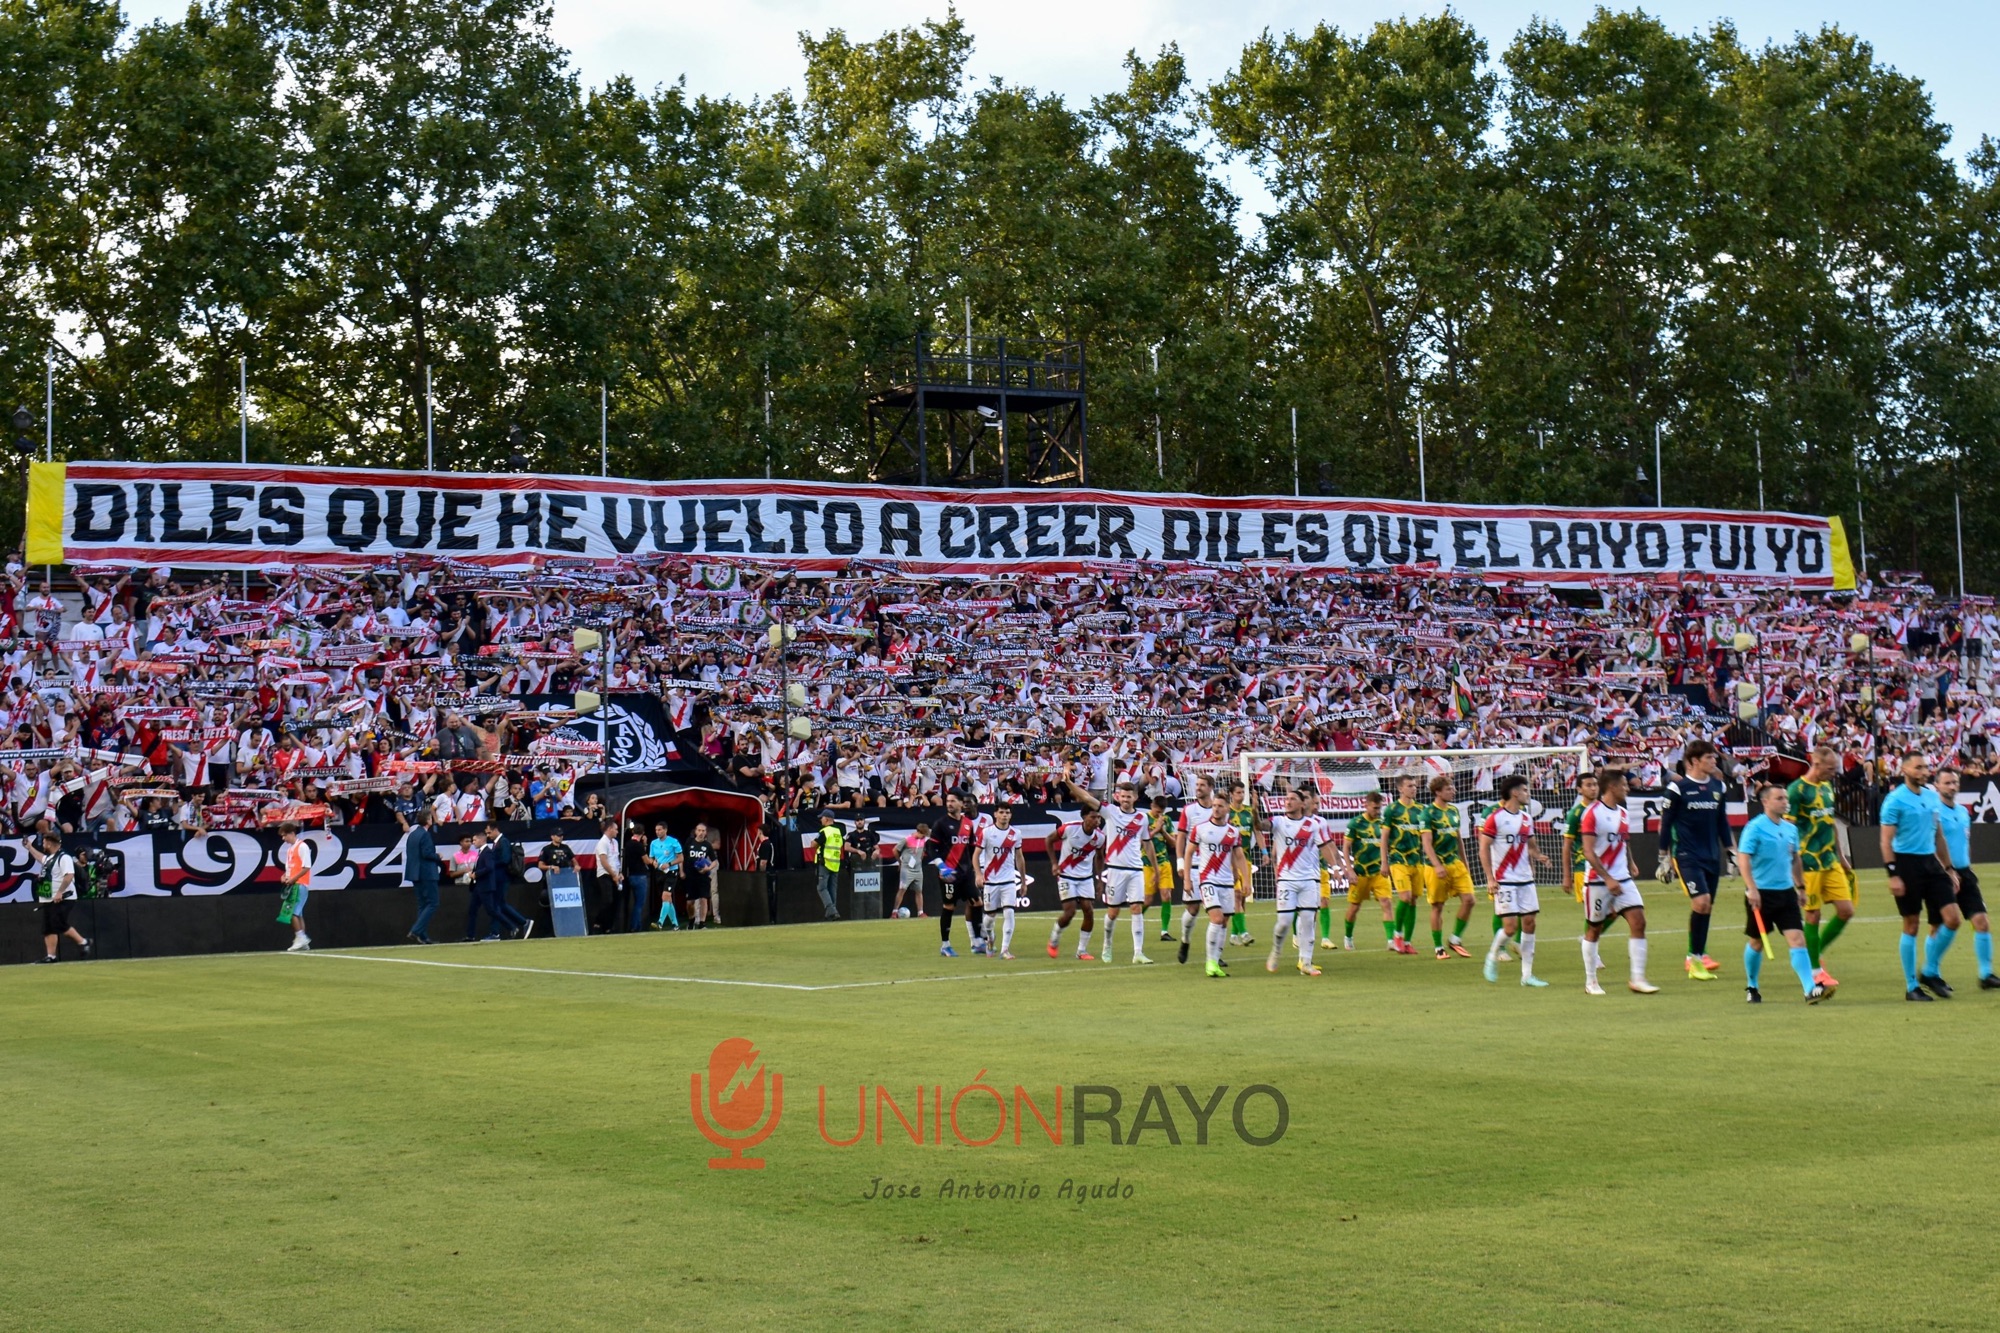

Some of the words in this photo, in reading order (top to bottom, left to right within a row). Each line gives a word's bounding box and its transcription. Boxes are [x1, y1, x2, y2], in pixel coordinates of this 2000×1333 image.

[71, 484, 305, 545] DILES
[326, 488, 483, 552] QUE
[496, 492, 587, 553] HE
[602, 496, 863, 554] VUELTO
[880, 502, 922, 557] A
[1162, 508, 1328, 564] DILES
[1344, 513, 1441, 568] QUE
[1452, 520, 1519, 568] EL
[1529, 520, 1671, 569] RAYO
[1682, 523, 1757, 571] FUI
[1766, 527, 1824, 574] YO
[203, 727, 227, 739] VETE
[1686, 800, 1720, 810] FONBET
[945, 883, 954, 893] 13
[1203, 886, 1215, 897] 20
[1278, 889, 1290, 900] 22
[1498, 891, 1513, 904] 23
[1594, 898, 1602, 911] 8
